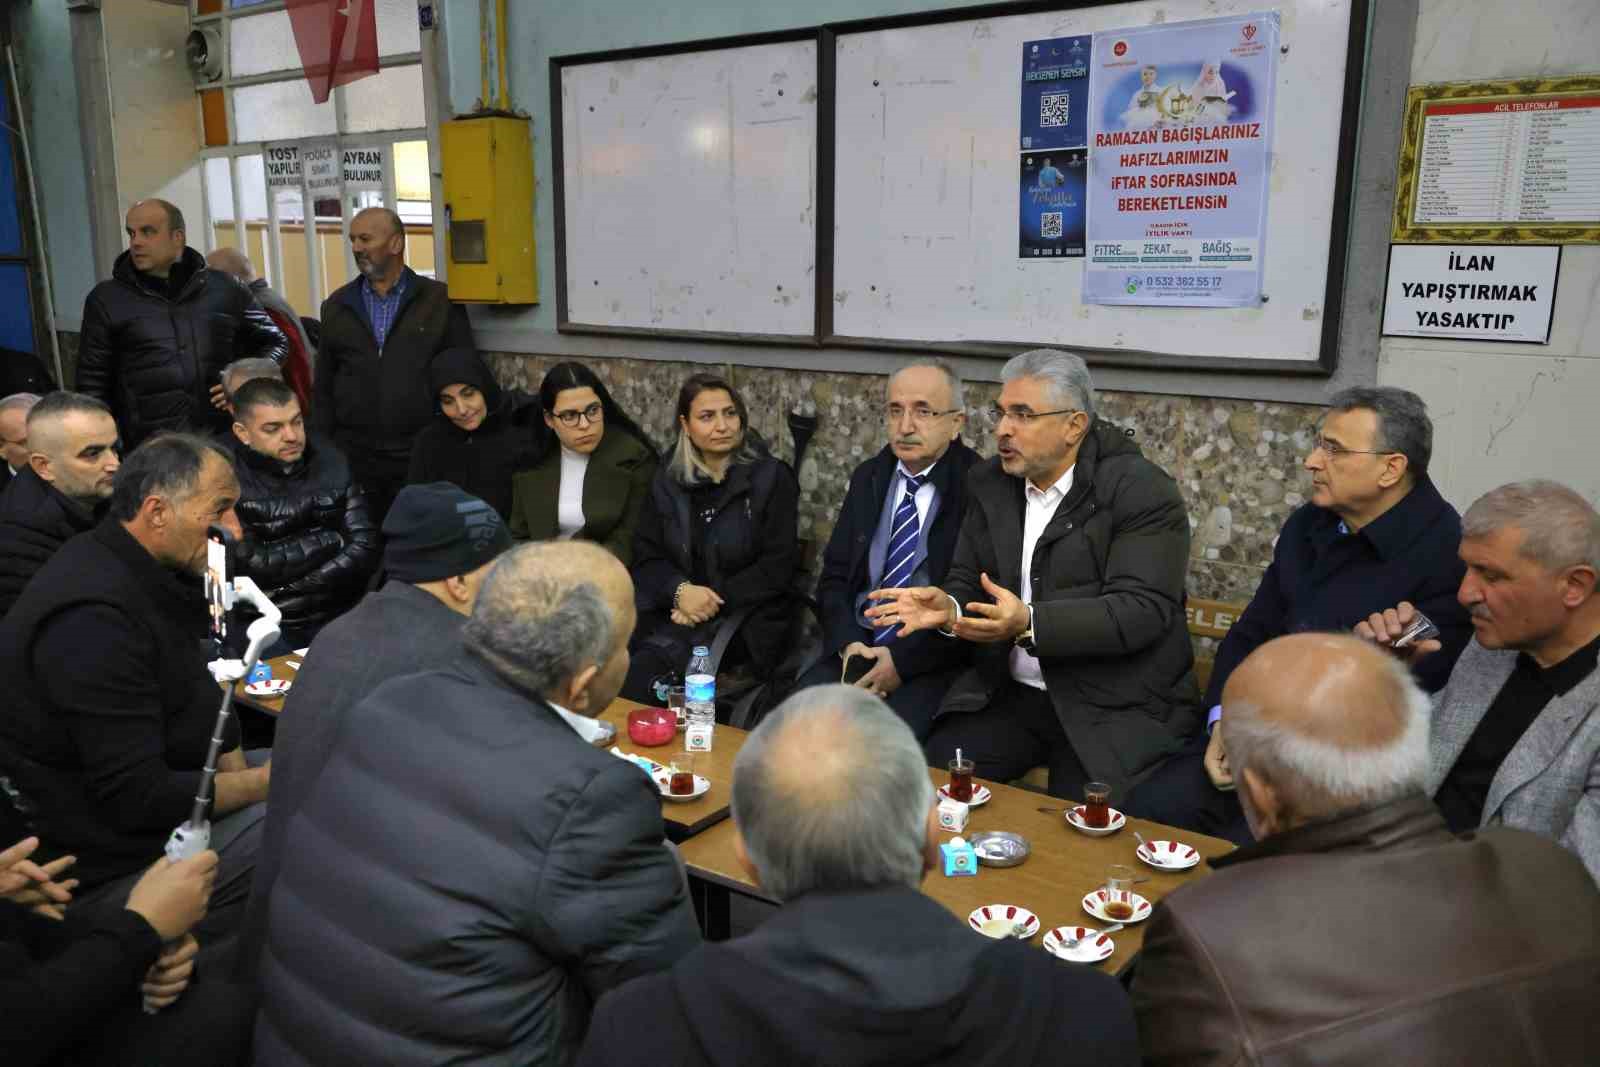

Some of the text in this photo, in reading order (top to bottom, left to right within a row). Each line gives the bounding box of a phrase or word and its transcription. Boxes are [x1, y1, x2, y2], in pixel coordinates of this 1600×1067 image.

[1096, 128, 1157, 147] RAMAZAN
[269, 146, 298, 160] TOST
[343, 151, 381, 165] AYRAN
[1120, 149, 1229, 167] HAFIZLARIMIZIN
[343, 169, 382, 182] BULUNUR
[1150, 171, 1237, 188] SOFRASINDA
[1143, 243, 1171, 255] ZEKAT
[1202, 240, 1232, 257] BAĞIŞ
[1448, 251, 1495, 271] İLAN
[1146, 276, 1153, 286] 0
[1212, 276, 1222, 286] 17
[1401, 282, 1538, 304] YAPIŞTIRMAK
